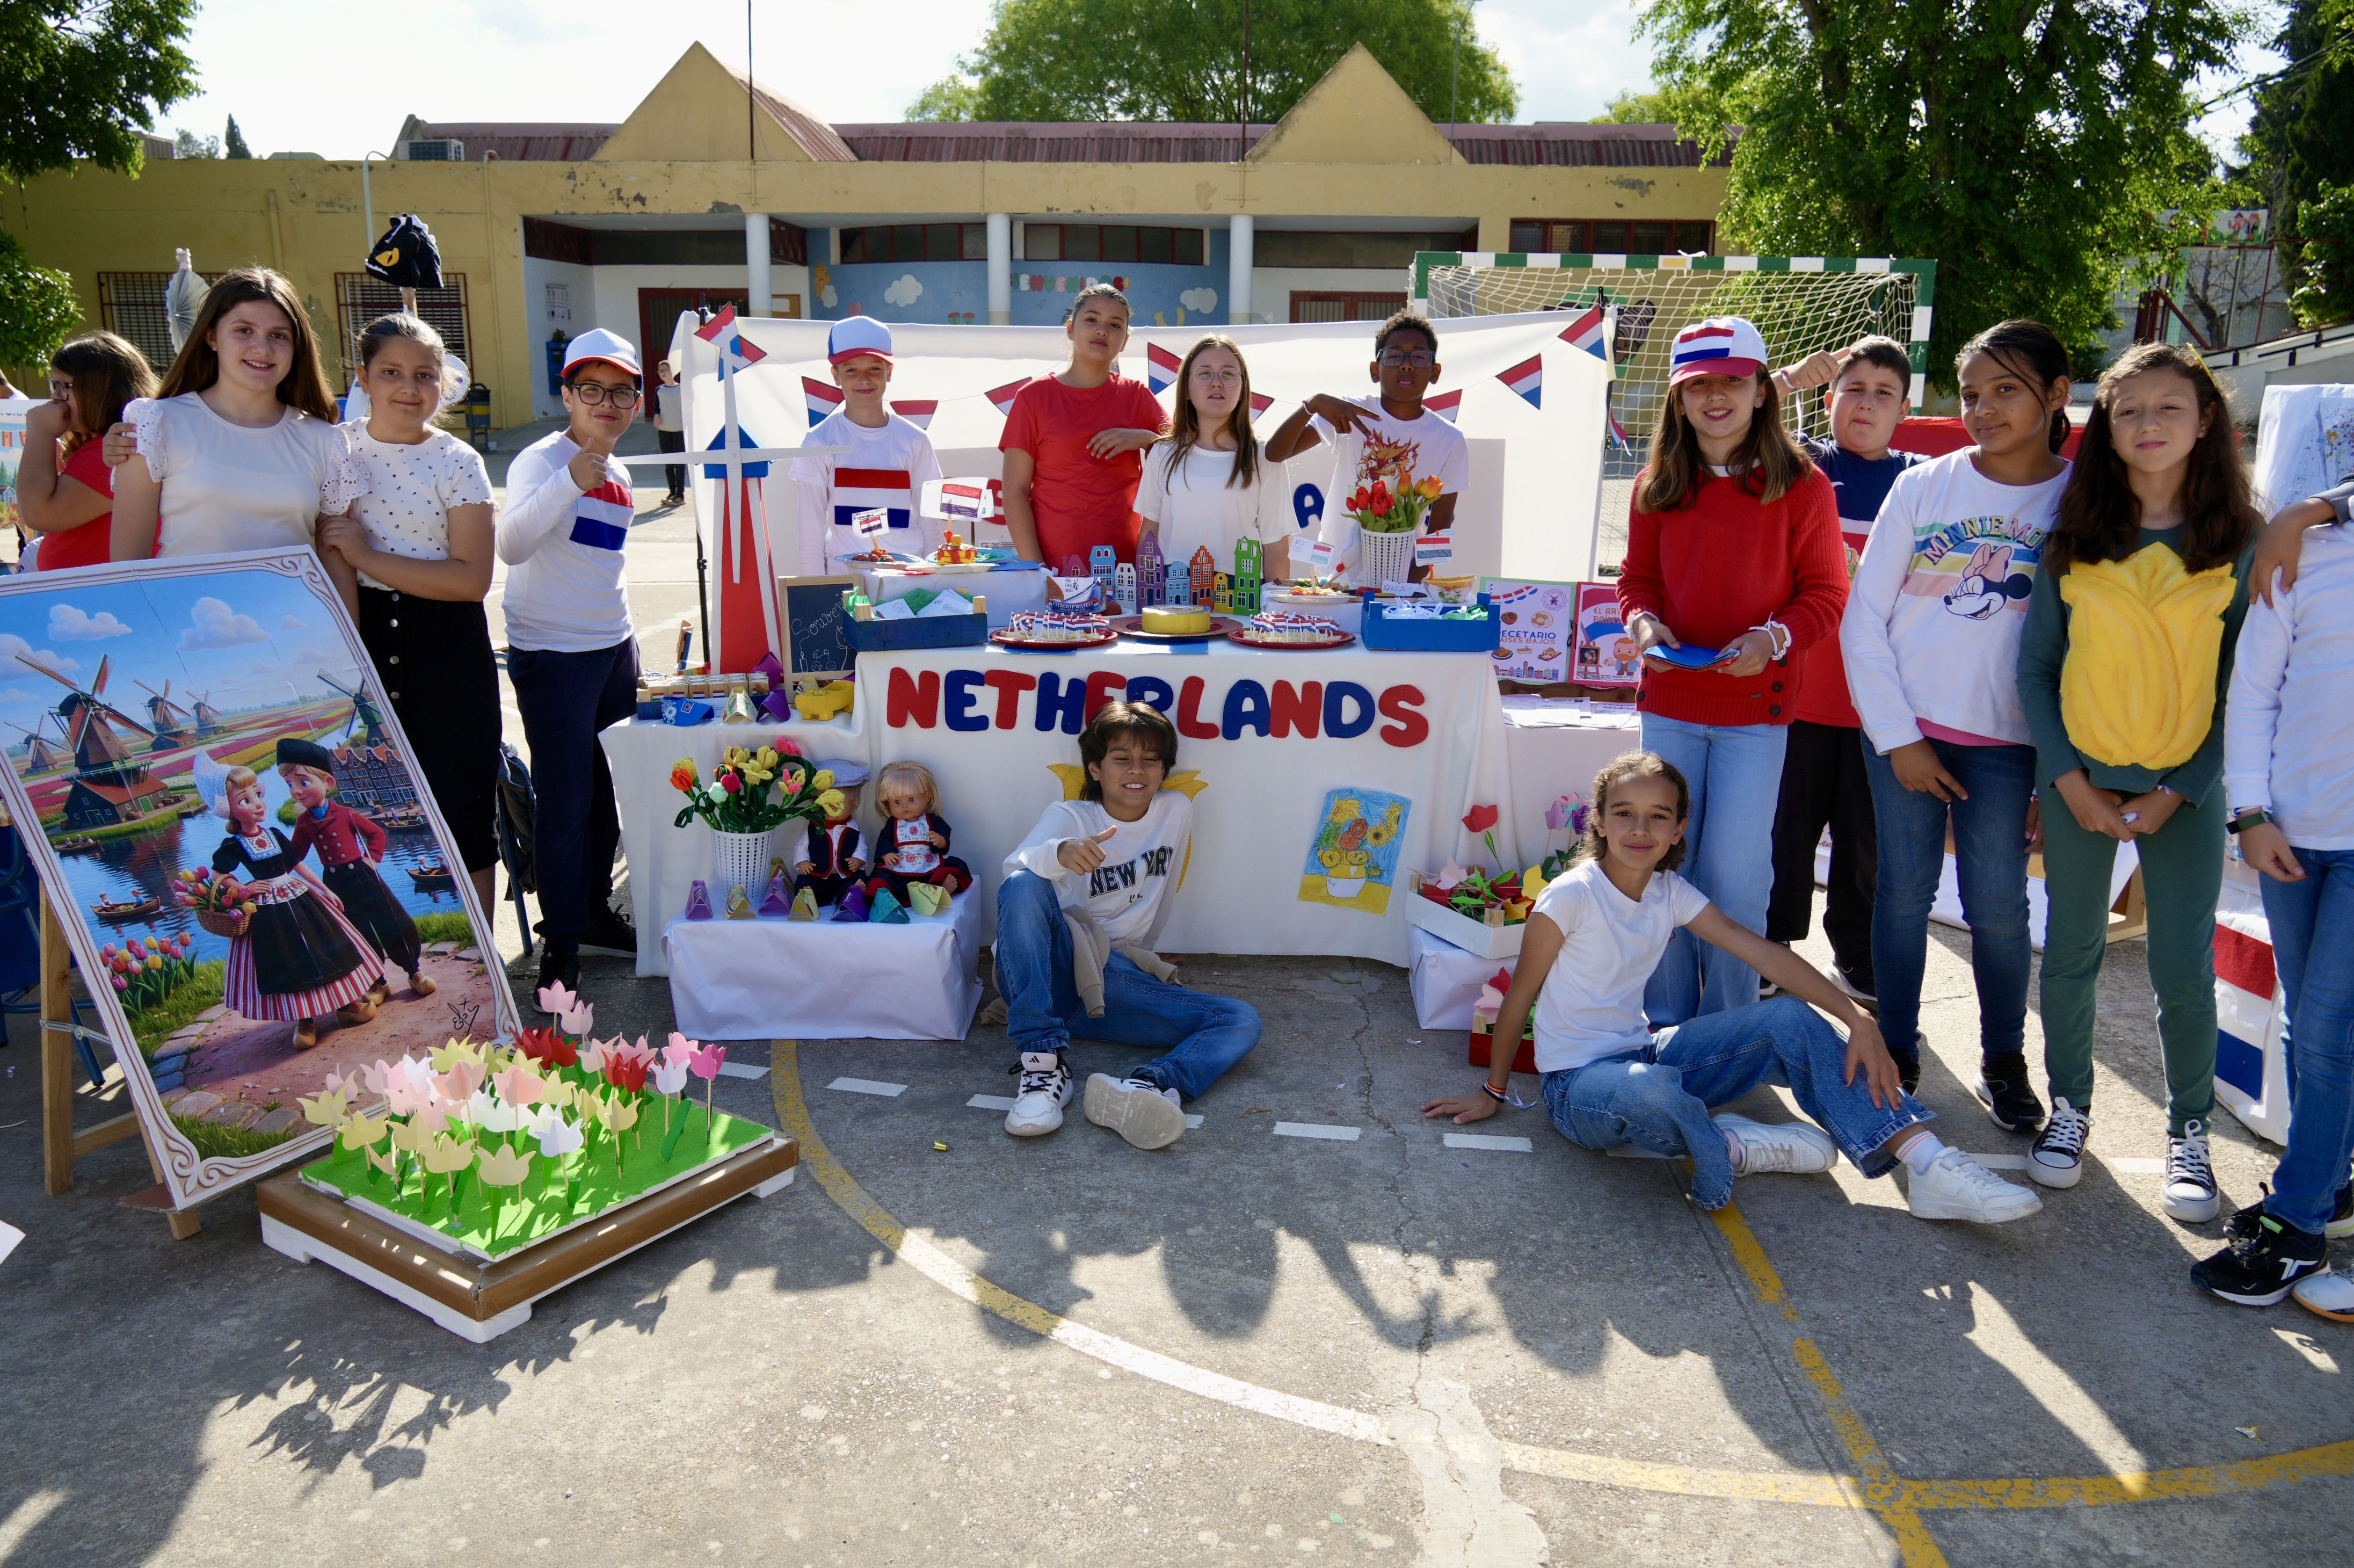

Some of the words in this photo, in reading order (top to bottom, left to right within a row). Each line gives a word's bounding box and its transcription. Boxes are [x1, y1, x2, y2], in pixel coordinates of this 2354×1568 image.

[1924, 515, 2004, 566] MINNIE
[1055, 601, 1094, 609] STROOPWAFELS
[1501, 630, 1556, 639] ECETARIO
[887, 667, 1429, 747] NETHERLANDS
[1089, 859, 1136, 898] NEW
